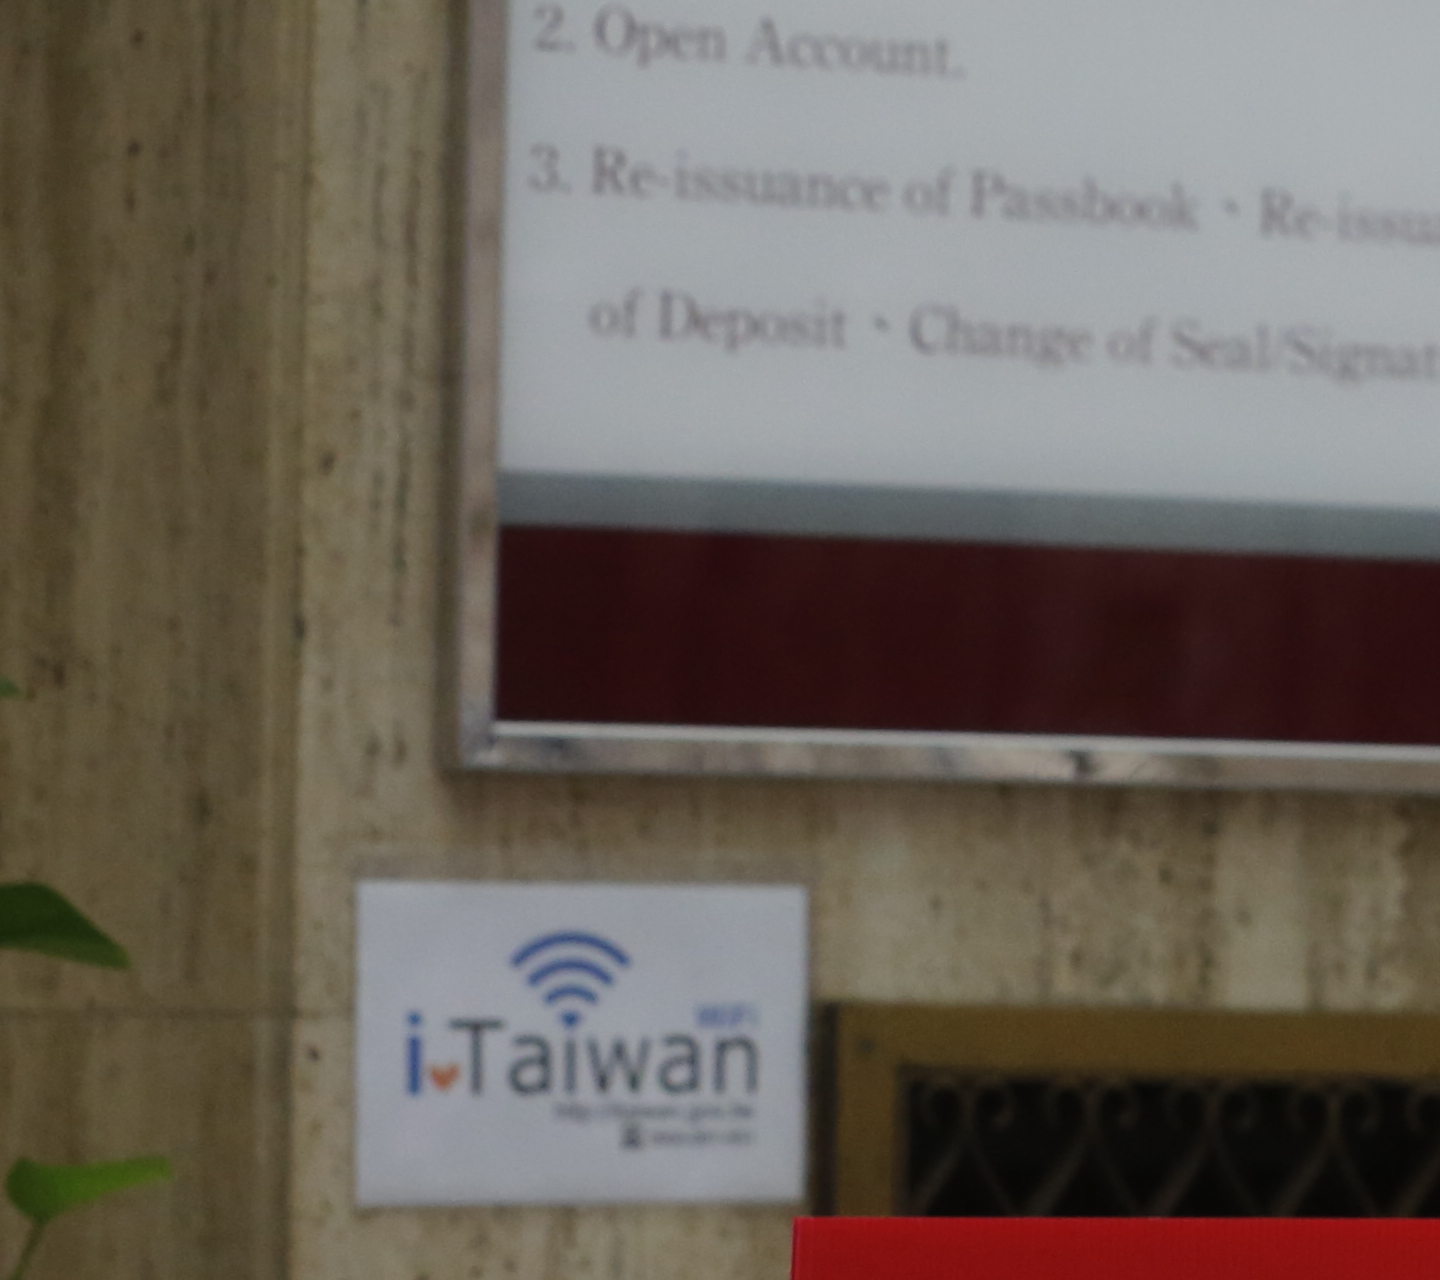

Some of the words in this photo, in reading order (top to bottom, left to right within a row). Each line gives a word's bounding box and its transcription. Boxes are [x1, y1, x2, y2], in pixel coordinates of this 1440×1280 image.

[533, 4, 574, 54] 2.
[592, 4, 728, 68] Open
[745, 18, 966, 80] Account.
[527, 143, 572, 196] 3.
[590, 143, 892, 214] Re-issuance
[903, 165, 959, 218] of
[589, 287, 643, 340] of
[657, 289, 848, 353] Deposit
[909, 302, 1094, 366] Change
[1105, 314, 1160, 366] of
